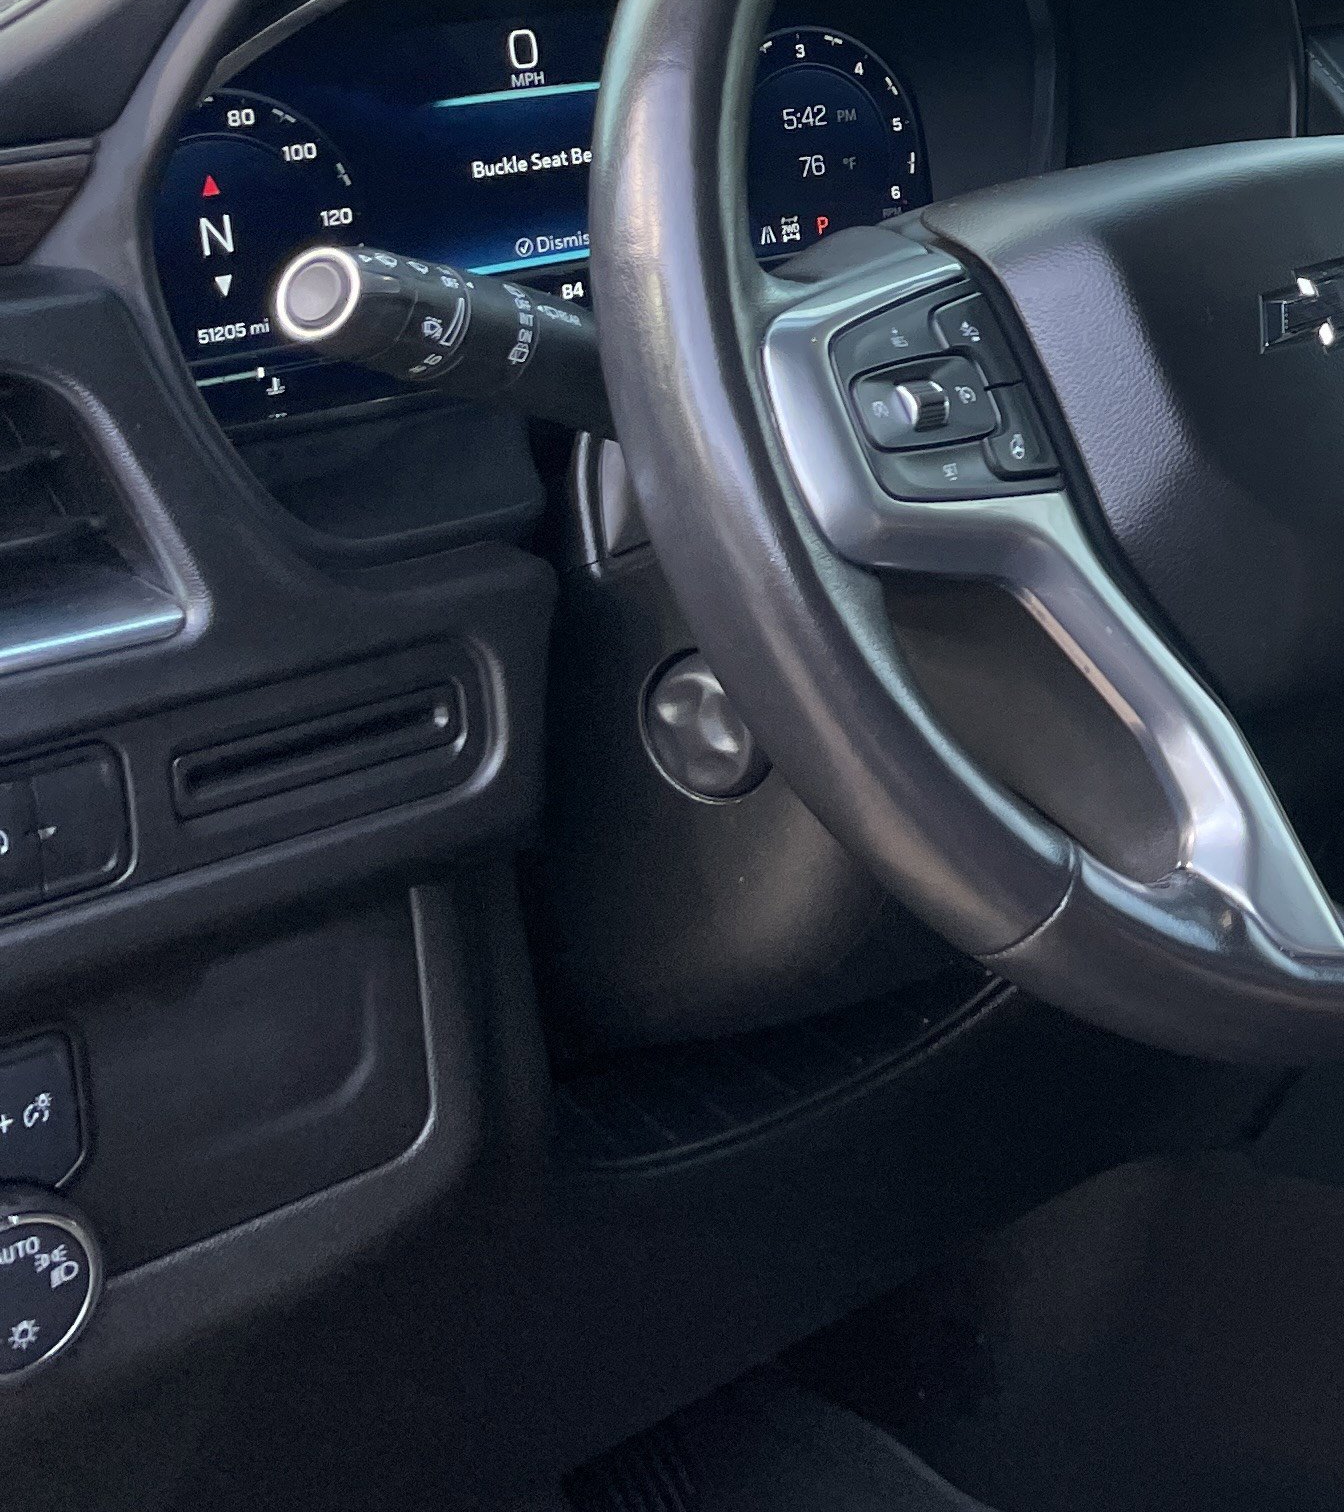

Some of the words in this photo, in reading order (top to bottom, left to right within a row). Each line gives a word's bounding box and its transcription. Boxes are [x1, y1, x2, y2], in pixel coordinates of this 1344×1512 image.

[506, 28, 539, 69] 0
[795, 44, 806, 58] 3
[511, 70, 545, 87] MPH
[854, 62, 864, 76] 4
[227, 108, 256, 127] 80
[782, 104, 828, 130] 5:42
[836, 108, 857, 124] PM
[891, 117, 902, 132] 5
[281, 142, 317, 162] 100
[471, 155, 528, 178] Buckle
[530, 150, 569, 171] Seat
[570, 147, 593, 164] Be
[798, 154, 826, 178] 76
[890, 185, 901, 200] 6
[320, 207, 354, 227] 120
[816, 216, 829, 235] P
[199, 214, 235, 257] N
[781, 223, 800, 236] 2WD
[536, 231, 590, 253] Dismis
[562, 281, 585, 300] 84
[197, 322, 247, 345] 51205
[250, 317, 270, 335] mi
